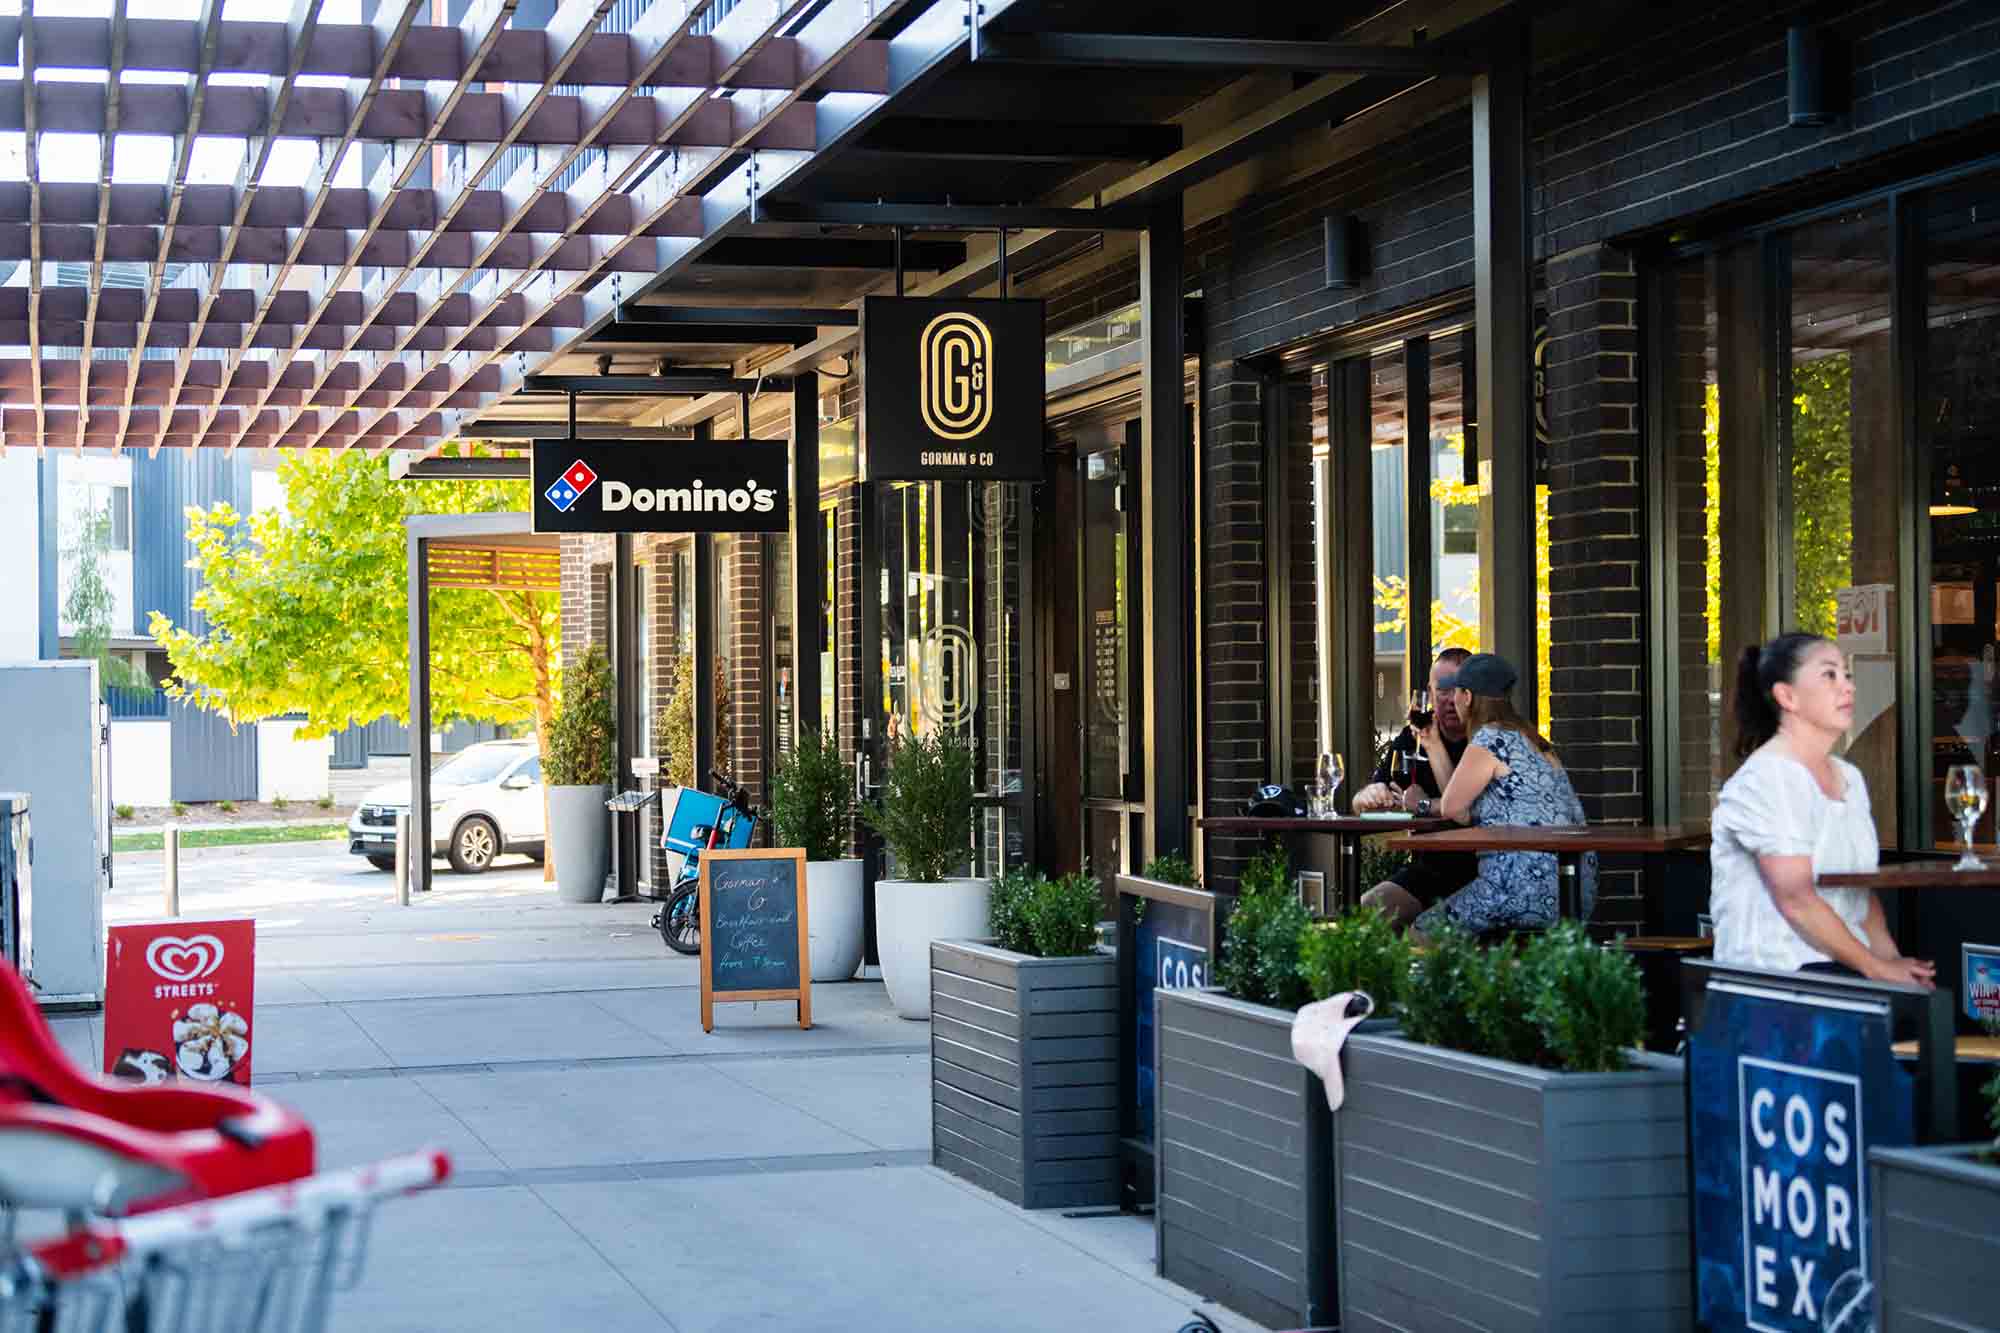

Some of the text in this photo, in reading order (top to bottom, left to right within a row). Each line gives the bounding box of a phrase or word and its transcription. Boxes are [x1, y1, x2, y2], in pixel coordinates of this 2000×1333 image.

[921, 452, 994, 466] GORMAN & CO
[602, 479, 775, 512] Domino's
[155, 983, 214, 998] STREETS
[1751, 1088, 1850, 1166] COS
[1753, 1166, 1852, 1250] MOR
[1755, 1245, 1817, 1321] EX
